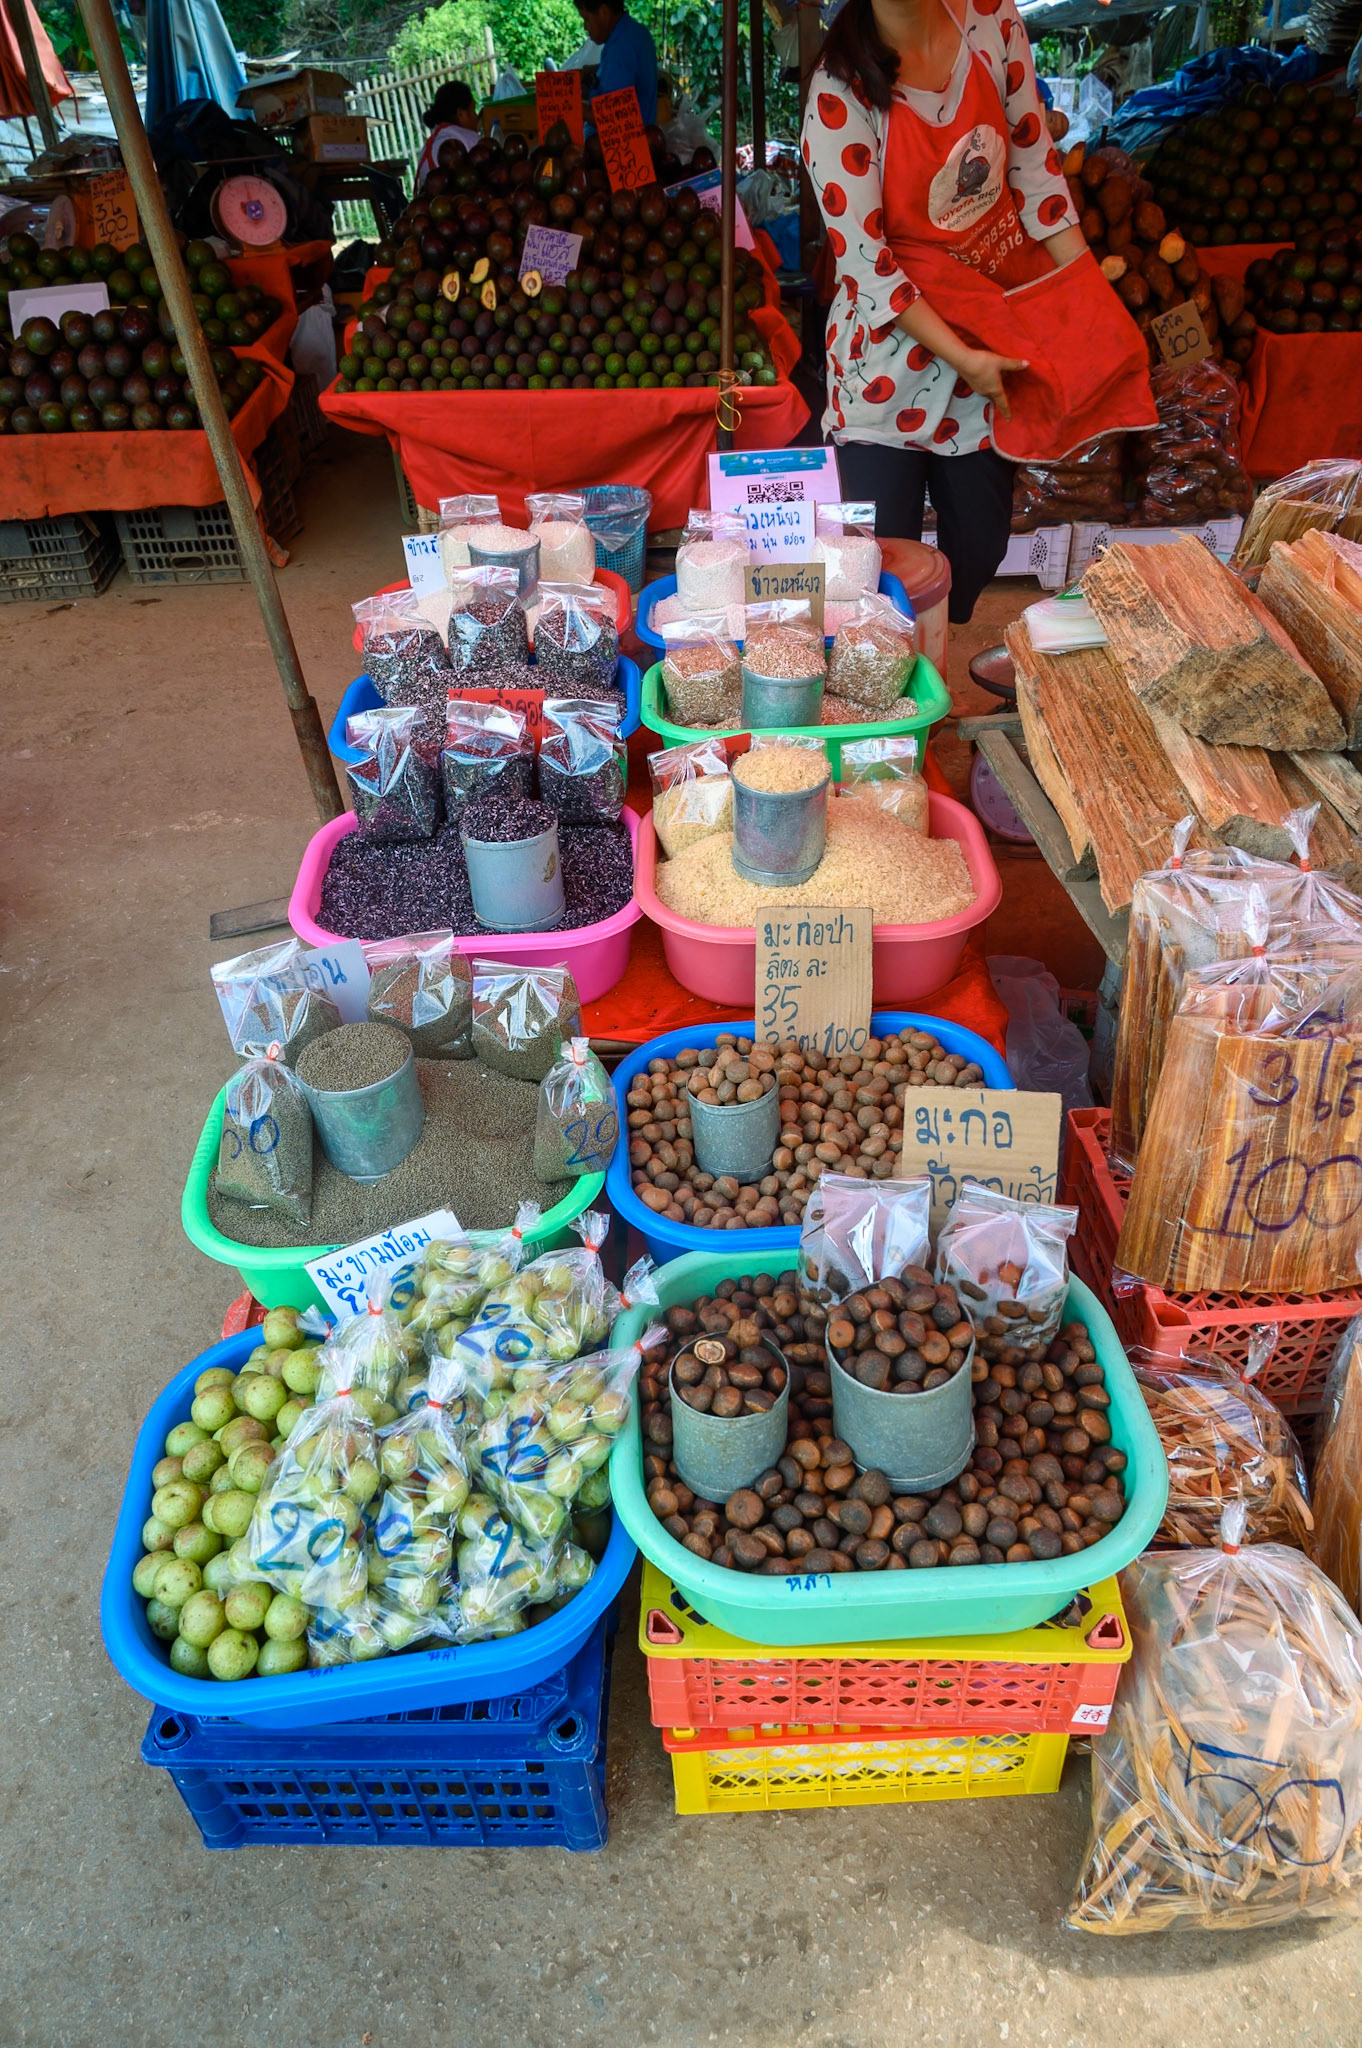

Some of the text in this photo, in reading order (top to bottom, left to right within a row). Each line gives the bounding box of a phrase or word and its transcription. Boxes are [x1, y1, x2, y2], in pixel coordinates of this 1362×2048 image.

[618, 165, 650, 190] 100
[98, 214, 129, 238] 100
[937, 197, 975, 226] TOYOTA
[977, 184, 1001, 202] RICH
[1169, 326, 1201, 359] 100
[733, 503, 801, 531] ้าวเหนียว
[751, 565, 822, 596] ข้าวเหนียว
[762, 984, 802, 1028] 35
[824, 1021, 868, 1057] 100
[564, 1110, 617, 1166] 20
[915, 1092, 1013, 1149] มะก่อ
[1193, 1139, 1362, 1240] 100
[317, 1228, 432, 1290] มะขามป้อม
[456, 1303, 534, 1362] 20
[255, 1501, 347, 1572] 20
